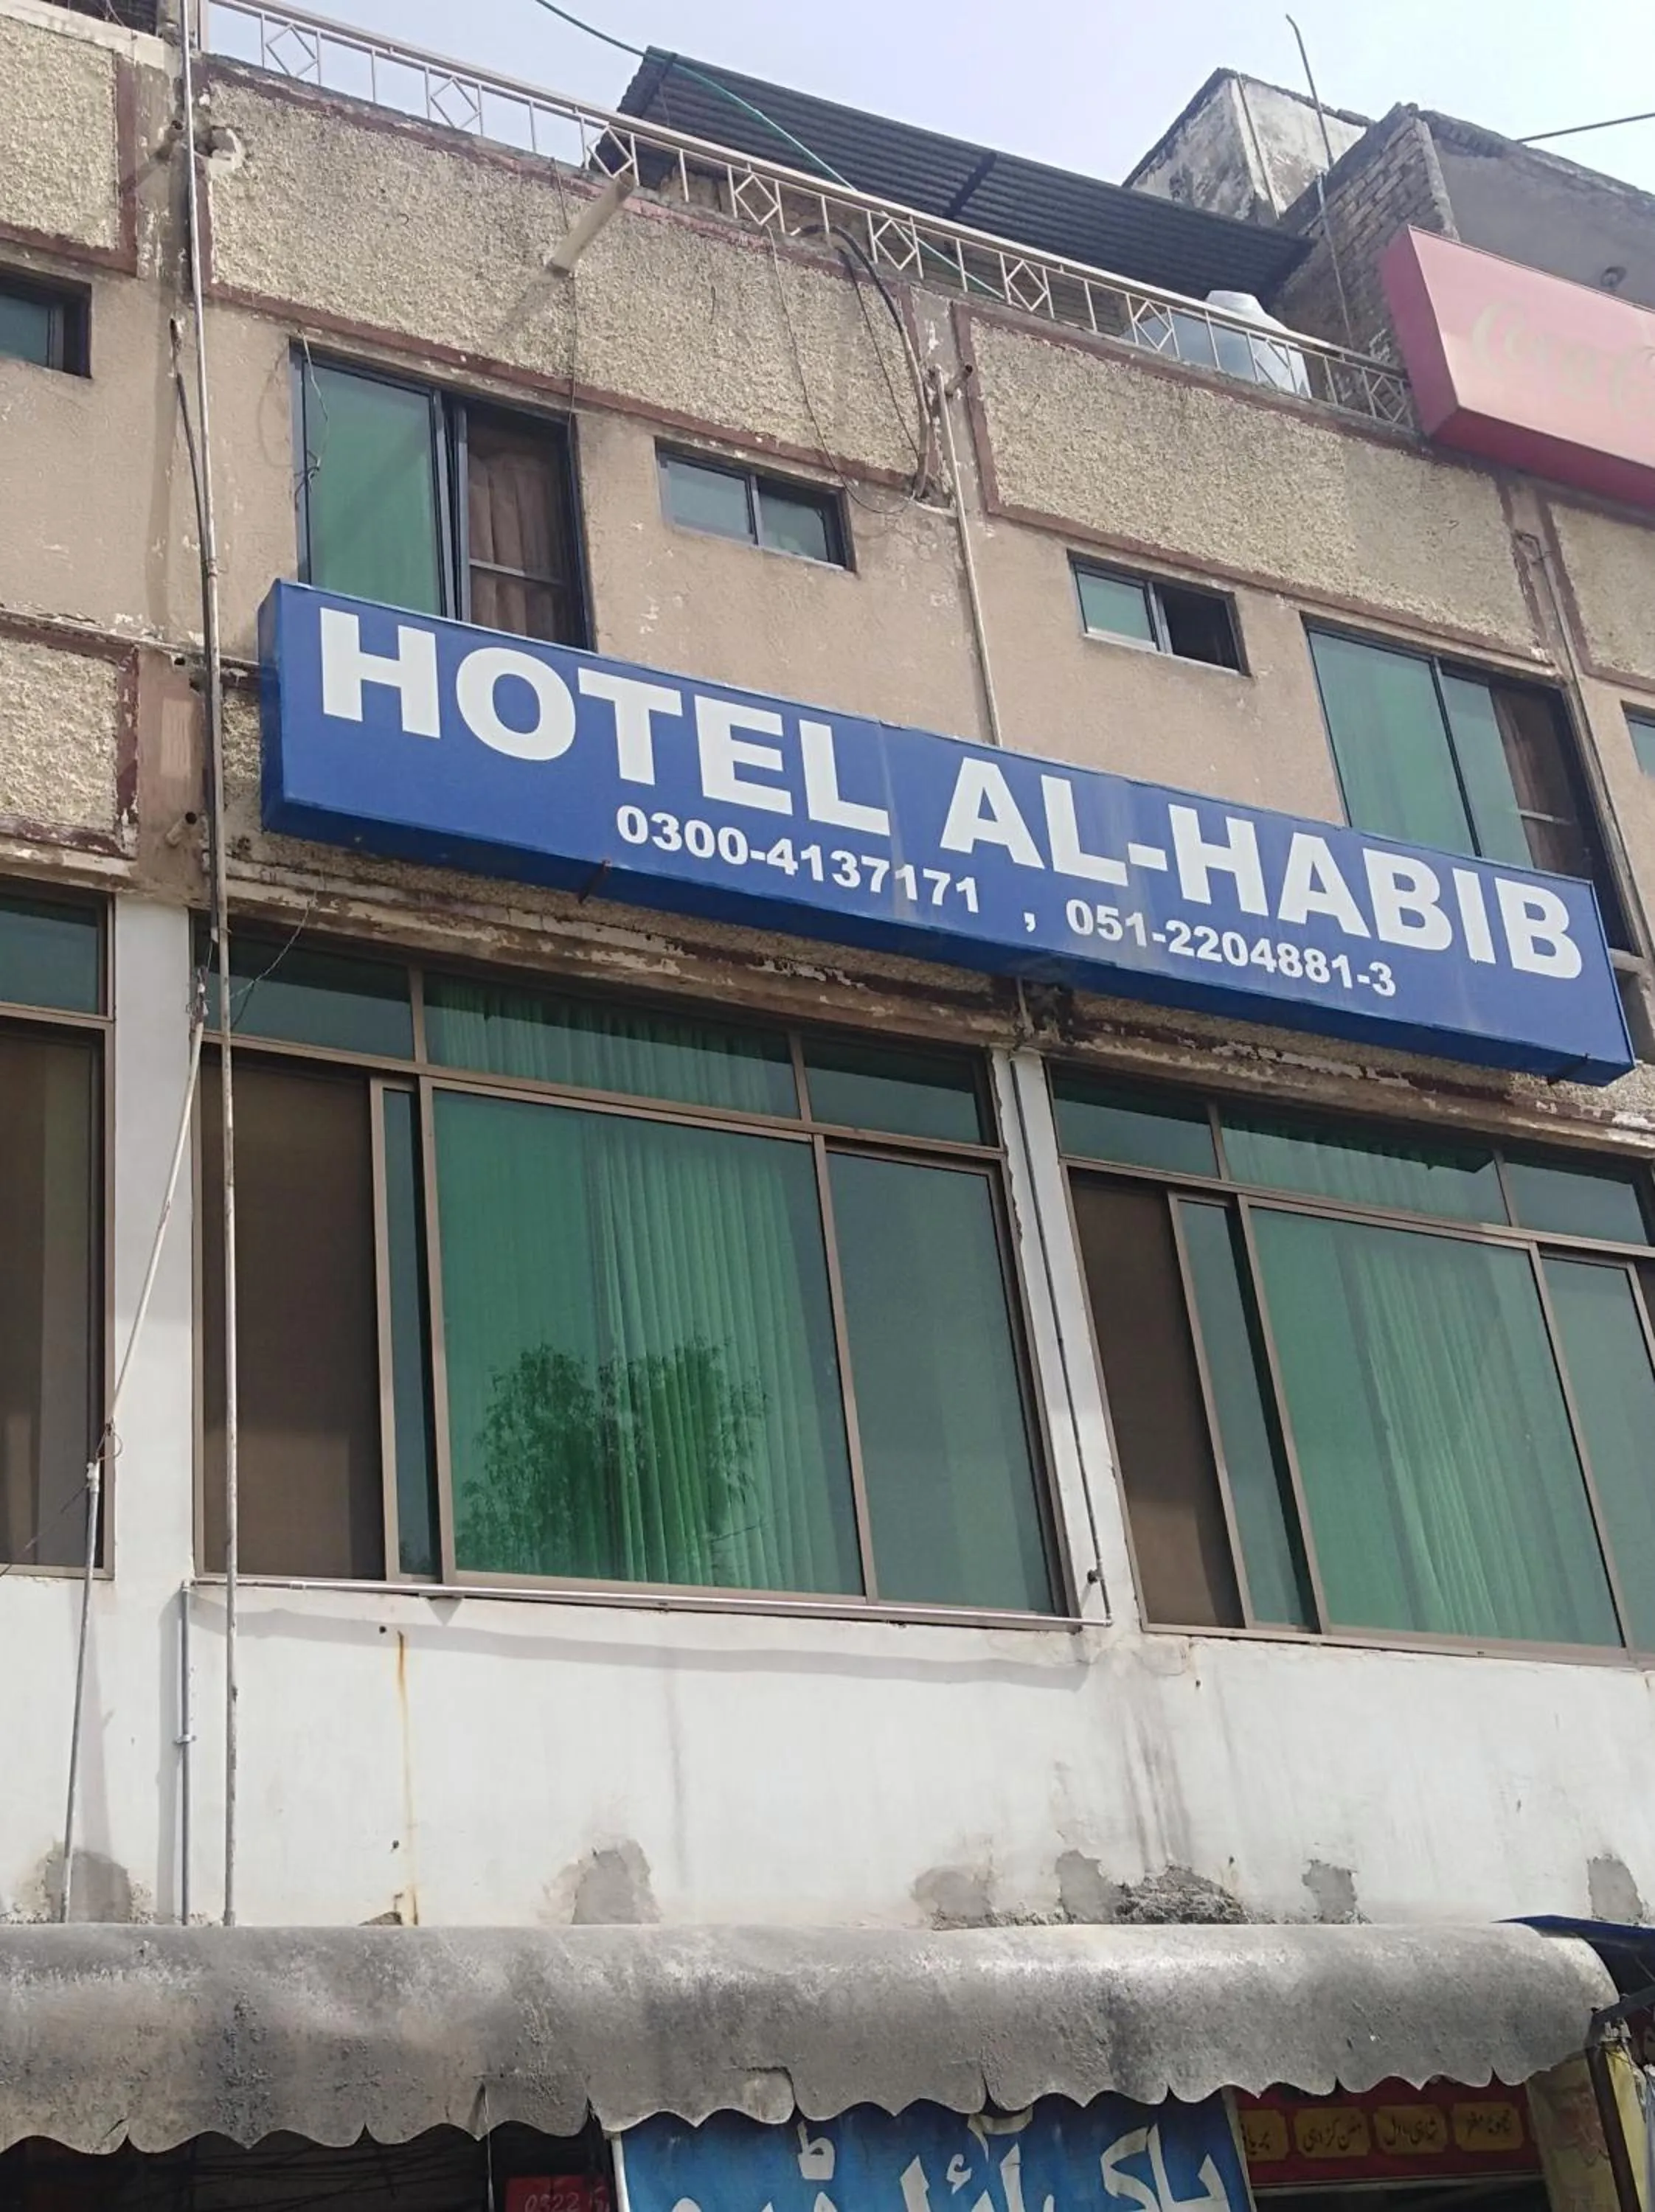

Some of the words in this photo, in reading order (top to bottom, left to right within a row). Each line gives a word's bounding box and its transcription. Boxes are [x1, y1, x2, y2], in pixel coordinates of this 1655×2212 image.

[319, 606, 891, 837] HOTEL
[939, 756, 1583, 980] AL-HABIB
[616, 804, 979, 914] 0300-4137171
[1065, 898, 1397, 997] 051-2204881-3
